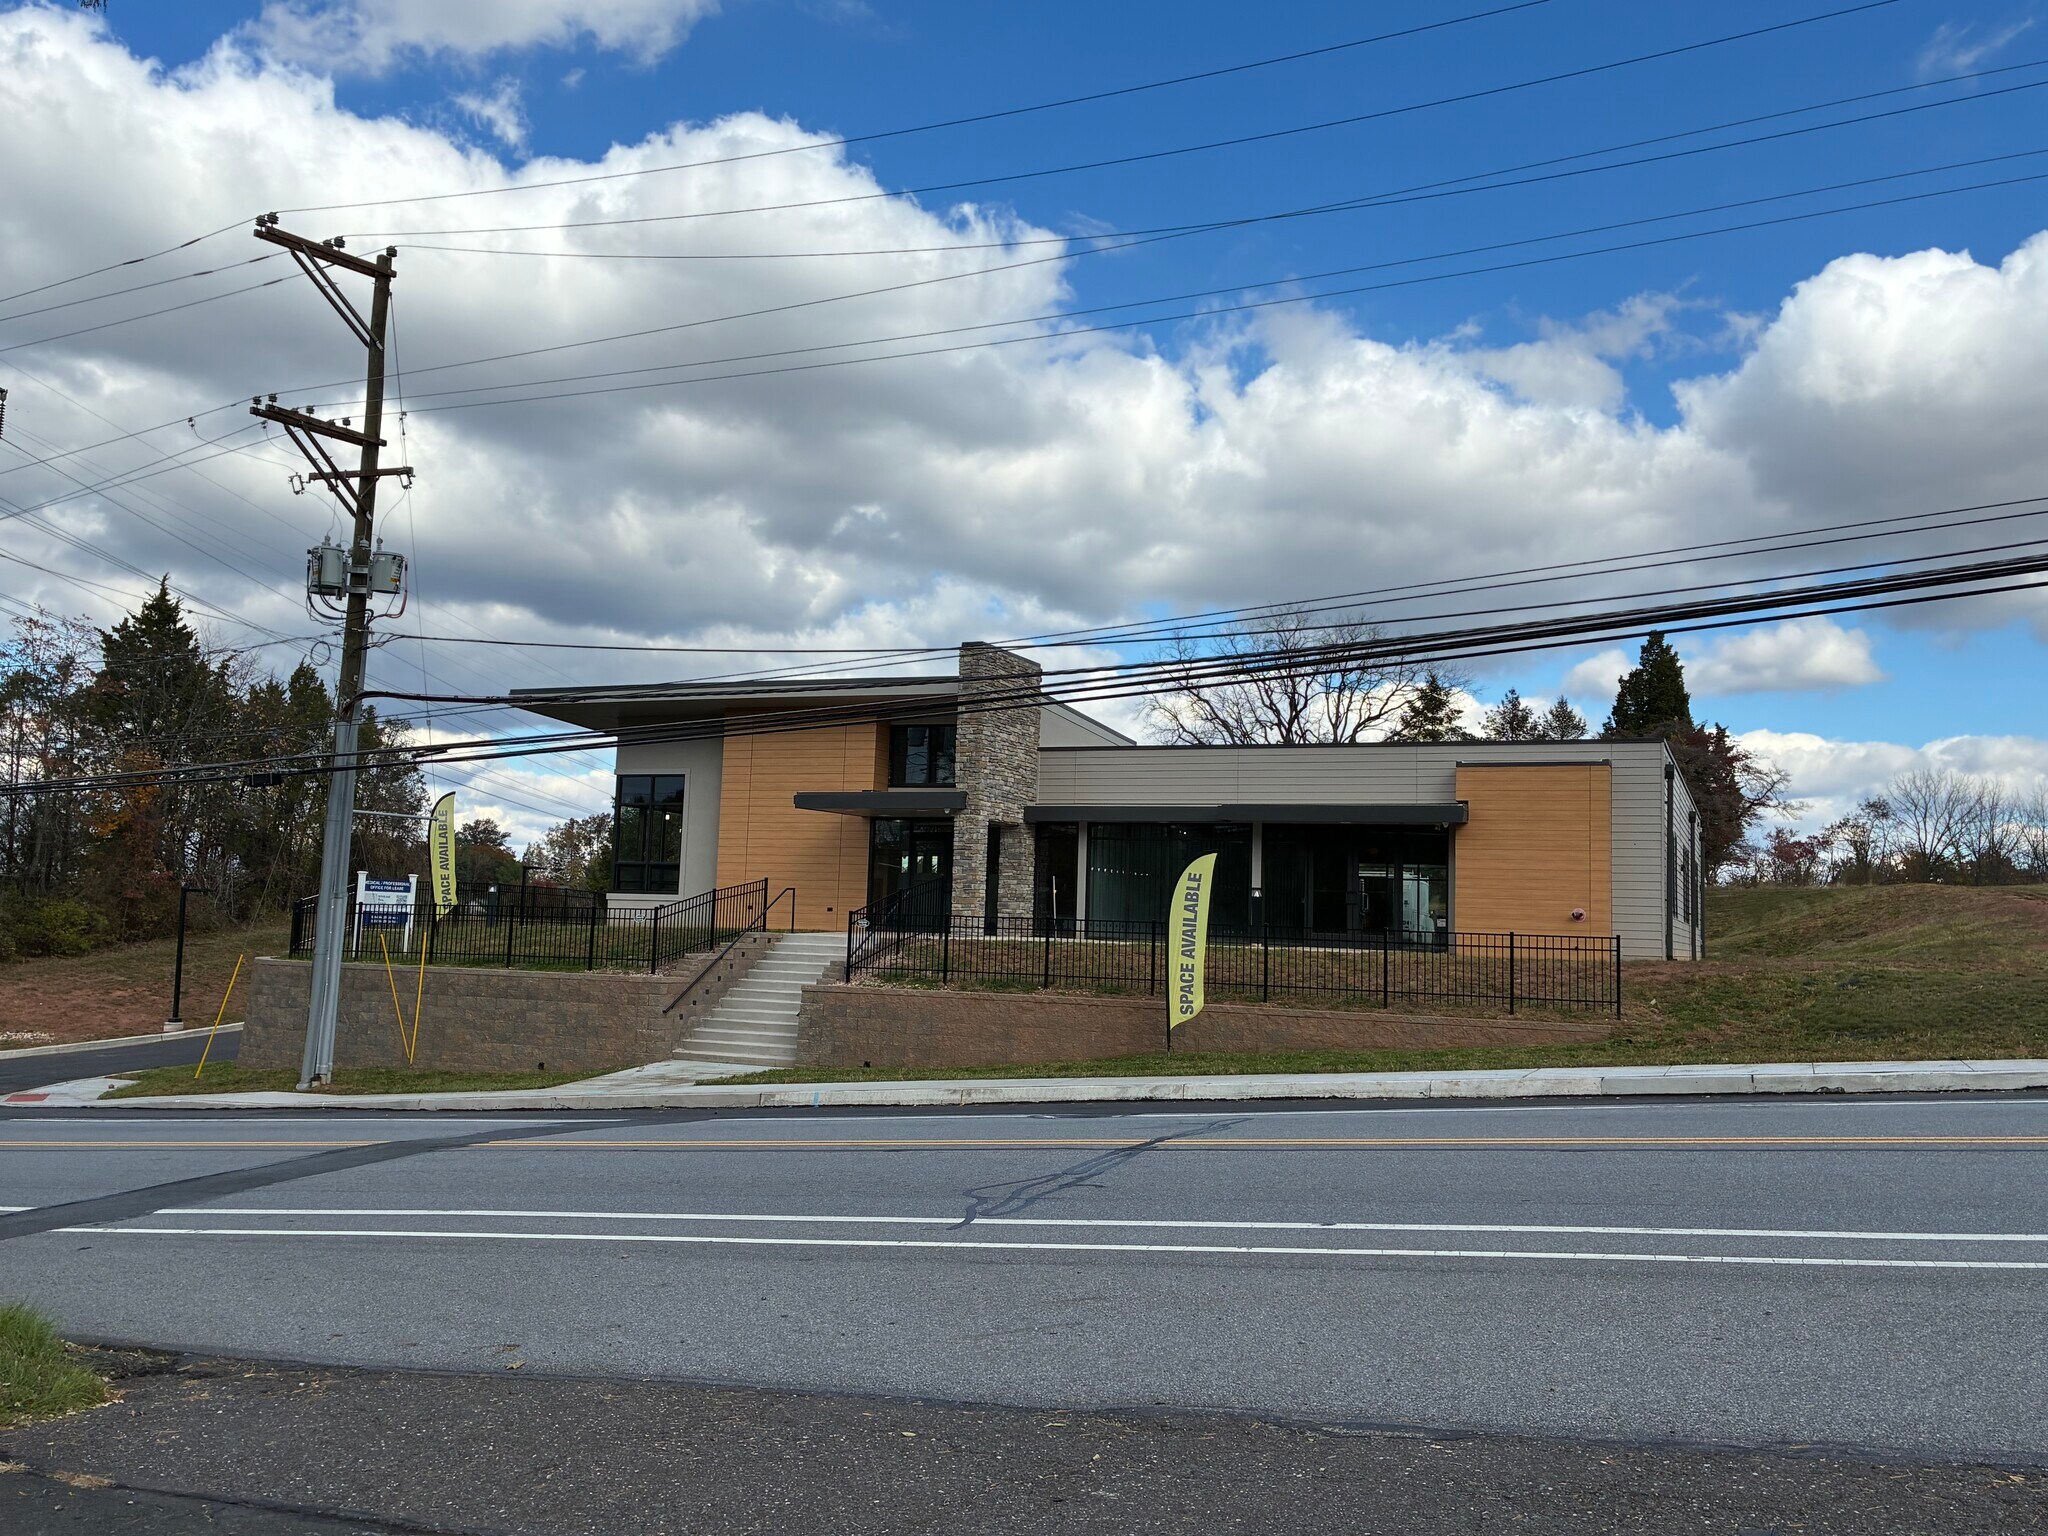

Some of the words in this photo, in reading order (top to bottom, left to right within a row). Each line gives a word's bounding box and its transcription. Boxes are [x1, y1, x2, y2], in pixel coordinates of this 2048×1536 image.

[438, 810, 450, 871] AVAILABLE
[1180, 872, 1203, 959] AVAILABLE
[1180, 963, 1194, 1015] SPACE
